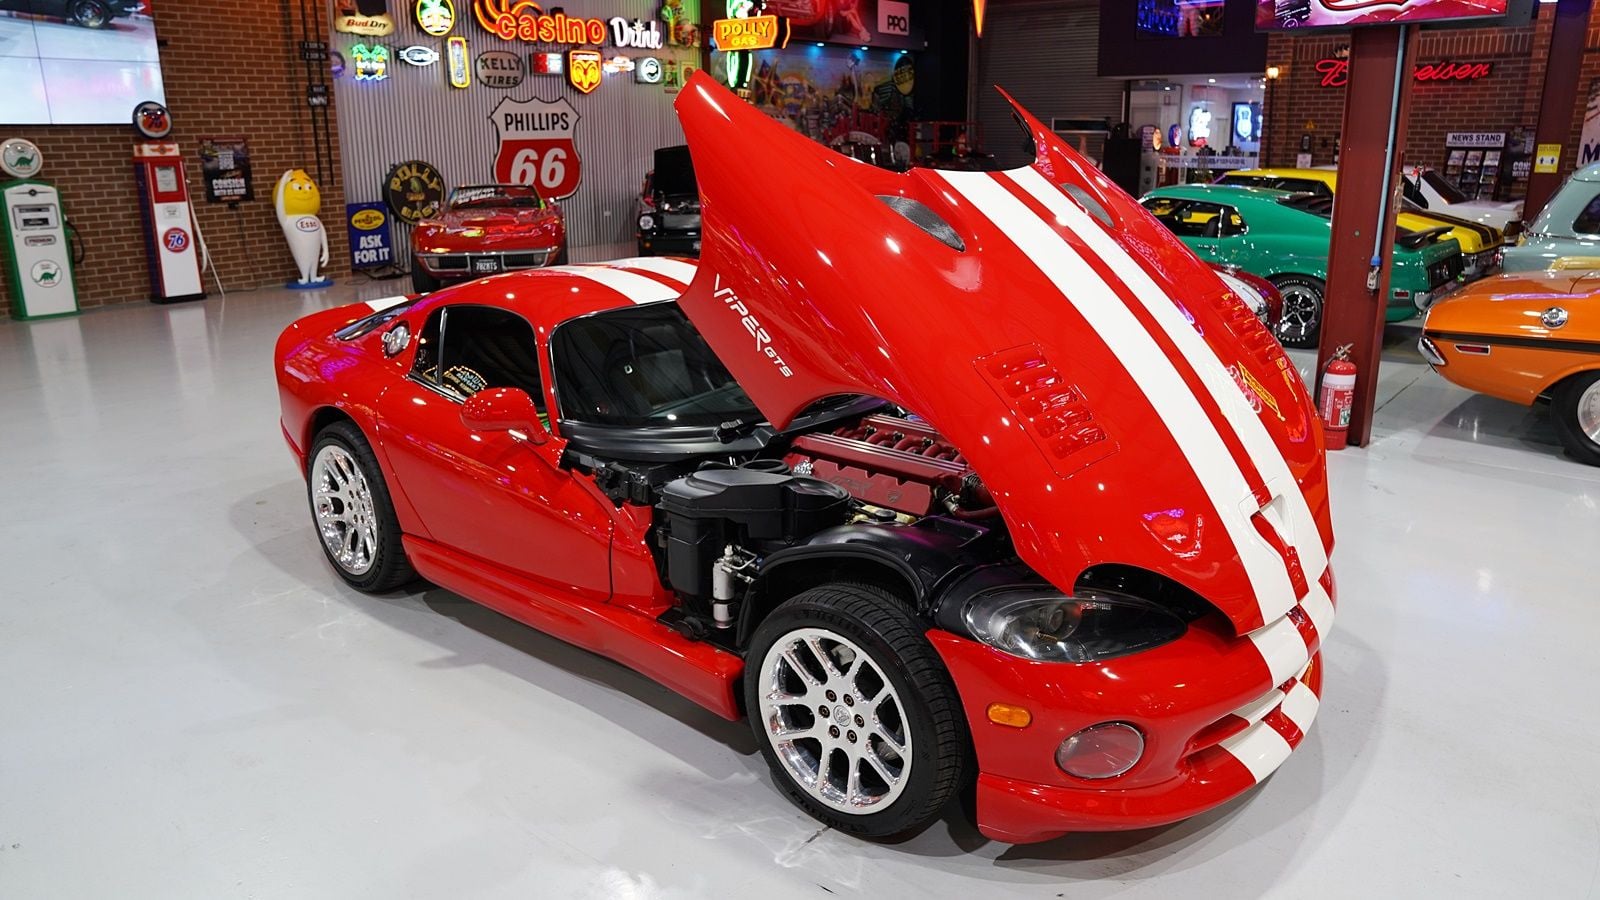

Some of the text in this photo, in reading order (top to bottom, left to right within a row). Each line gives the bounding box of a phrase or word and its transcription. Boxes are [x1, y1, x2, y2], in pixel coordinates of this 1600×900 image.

[346, 18, 388, 29] Bud Dry
[720, 20, 771, 41] POLLY
[610, 17, 663, 49] Drink
[731, 36, 757, 46] GAS
[480, 57, 520, 72] KELLY
[485, 75, 519, 86] TIRES
[504, 112, 569, 131] PHILLIPS
[1451, 134, 1502, 142] NEWS STAND
[510, 147, 567, 188] 66
[390, 163, 441, 192] POLLY
[401, 205, 433, 219] GAS
[168, 235, 185, 248] 76
[360, 234, 383, 249] ASK
[354, 247, 390, 264] FOR IT
[713, 273, 794, 377] VIPER GTS
